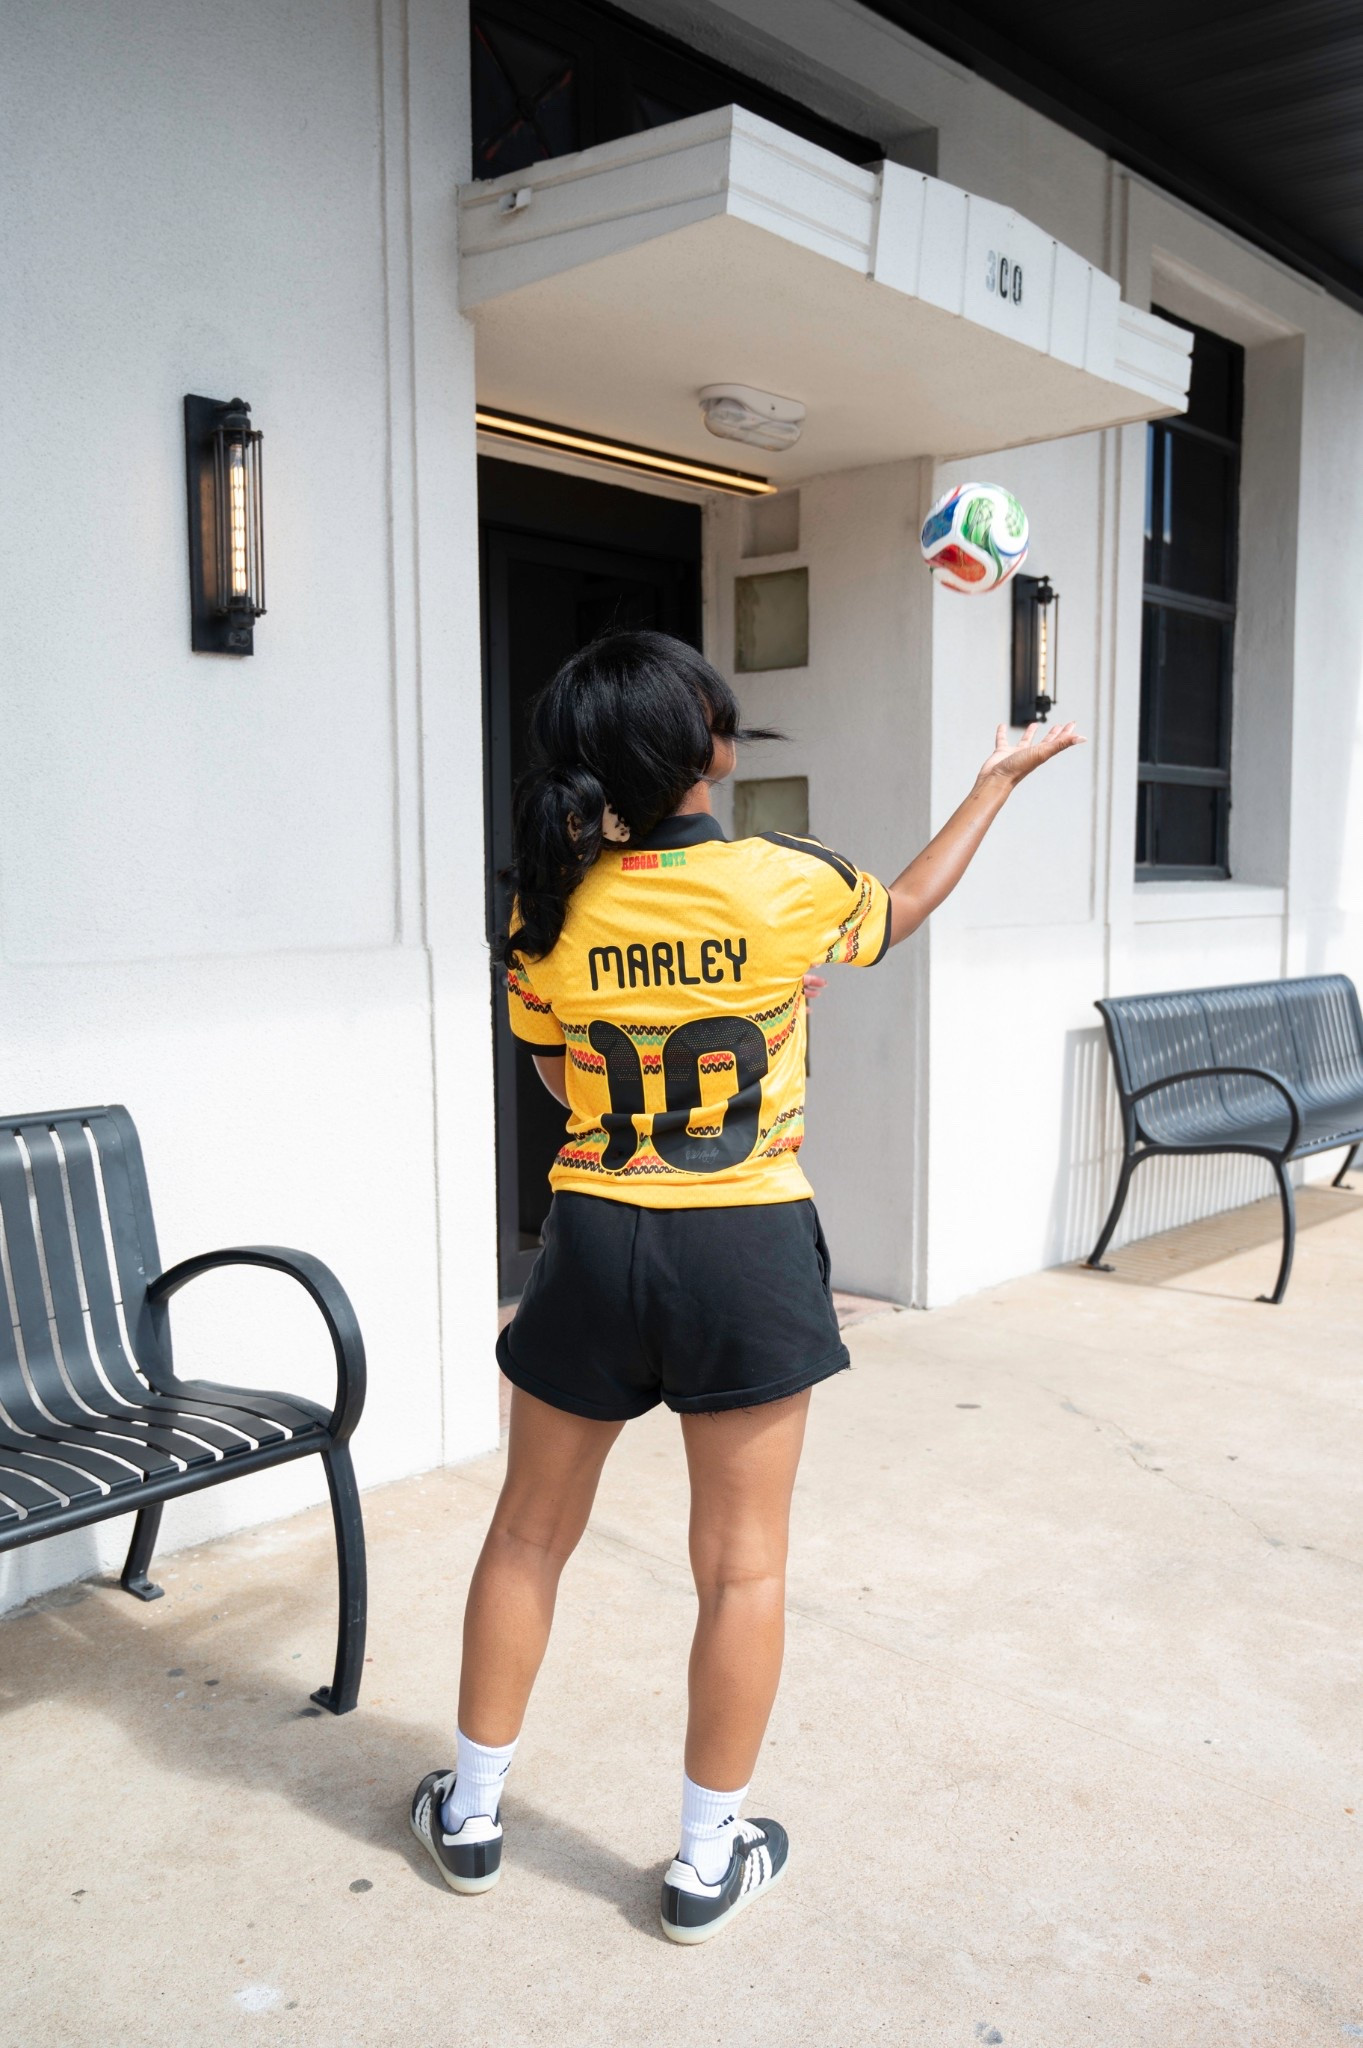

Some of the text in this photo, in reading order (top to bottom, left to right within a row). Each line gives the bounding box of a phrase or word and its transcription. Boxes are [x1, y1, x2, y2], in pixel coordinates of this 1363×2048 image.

[622, 851, 687, 871] REGGAE BOYZ
[588, 937, 747, 991] MARLEY
[588, 1015, 769, 1173] 10
